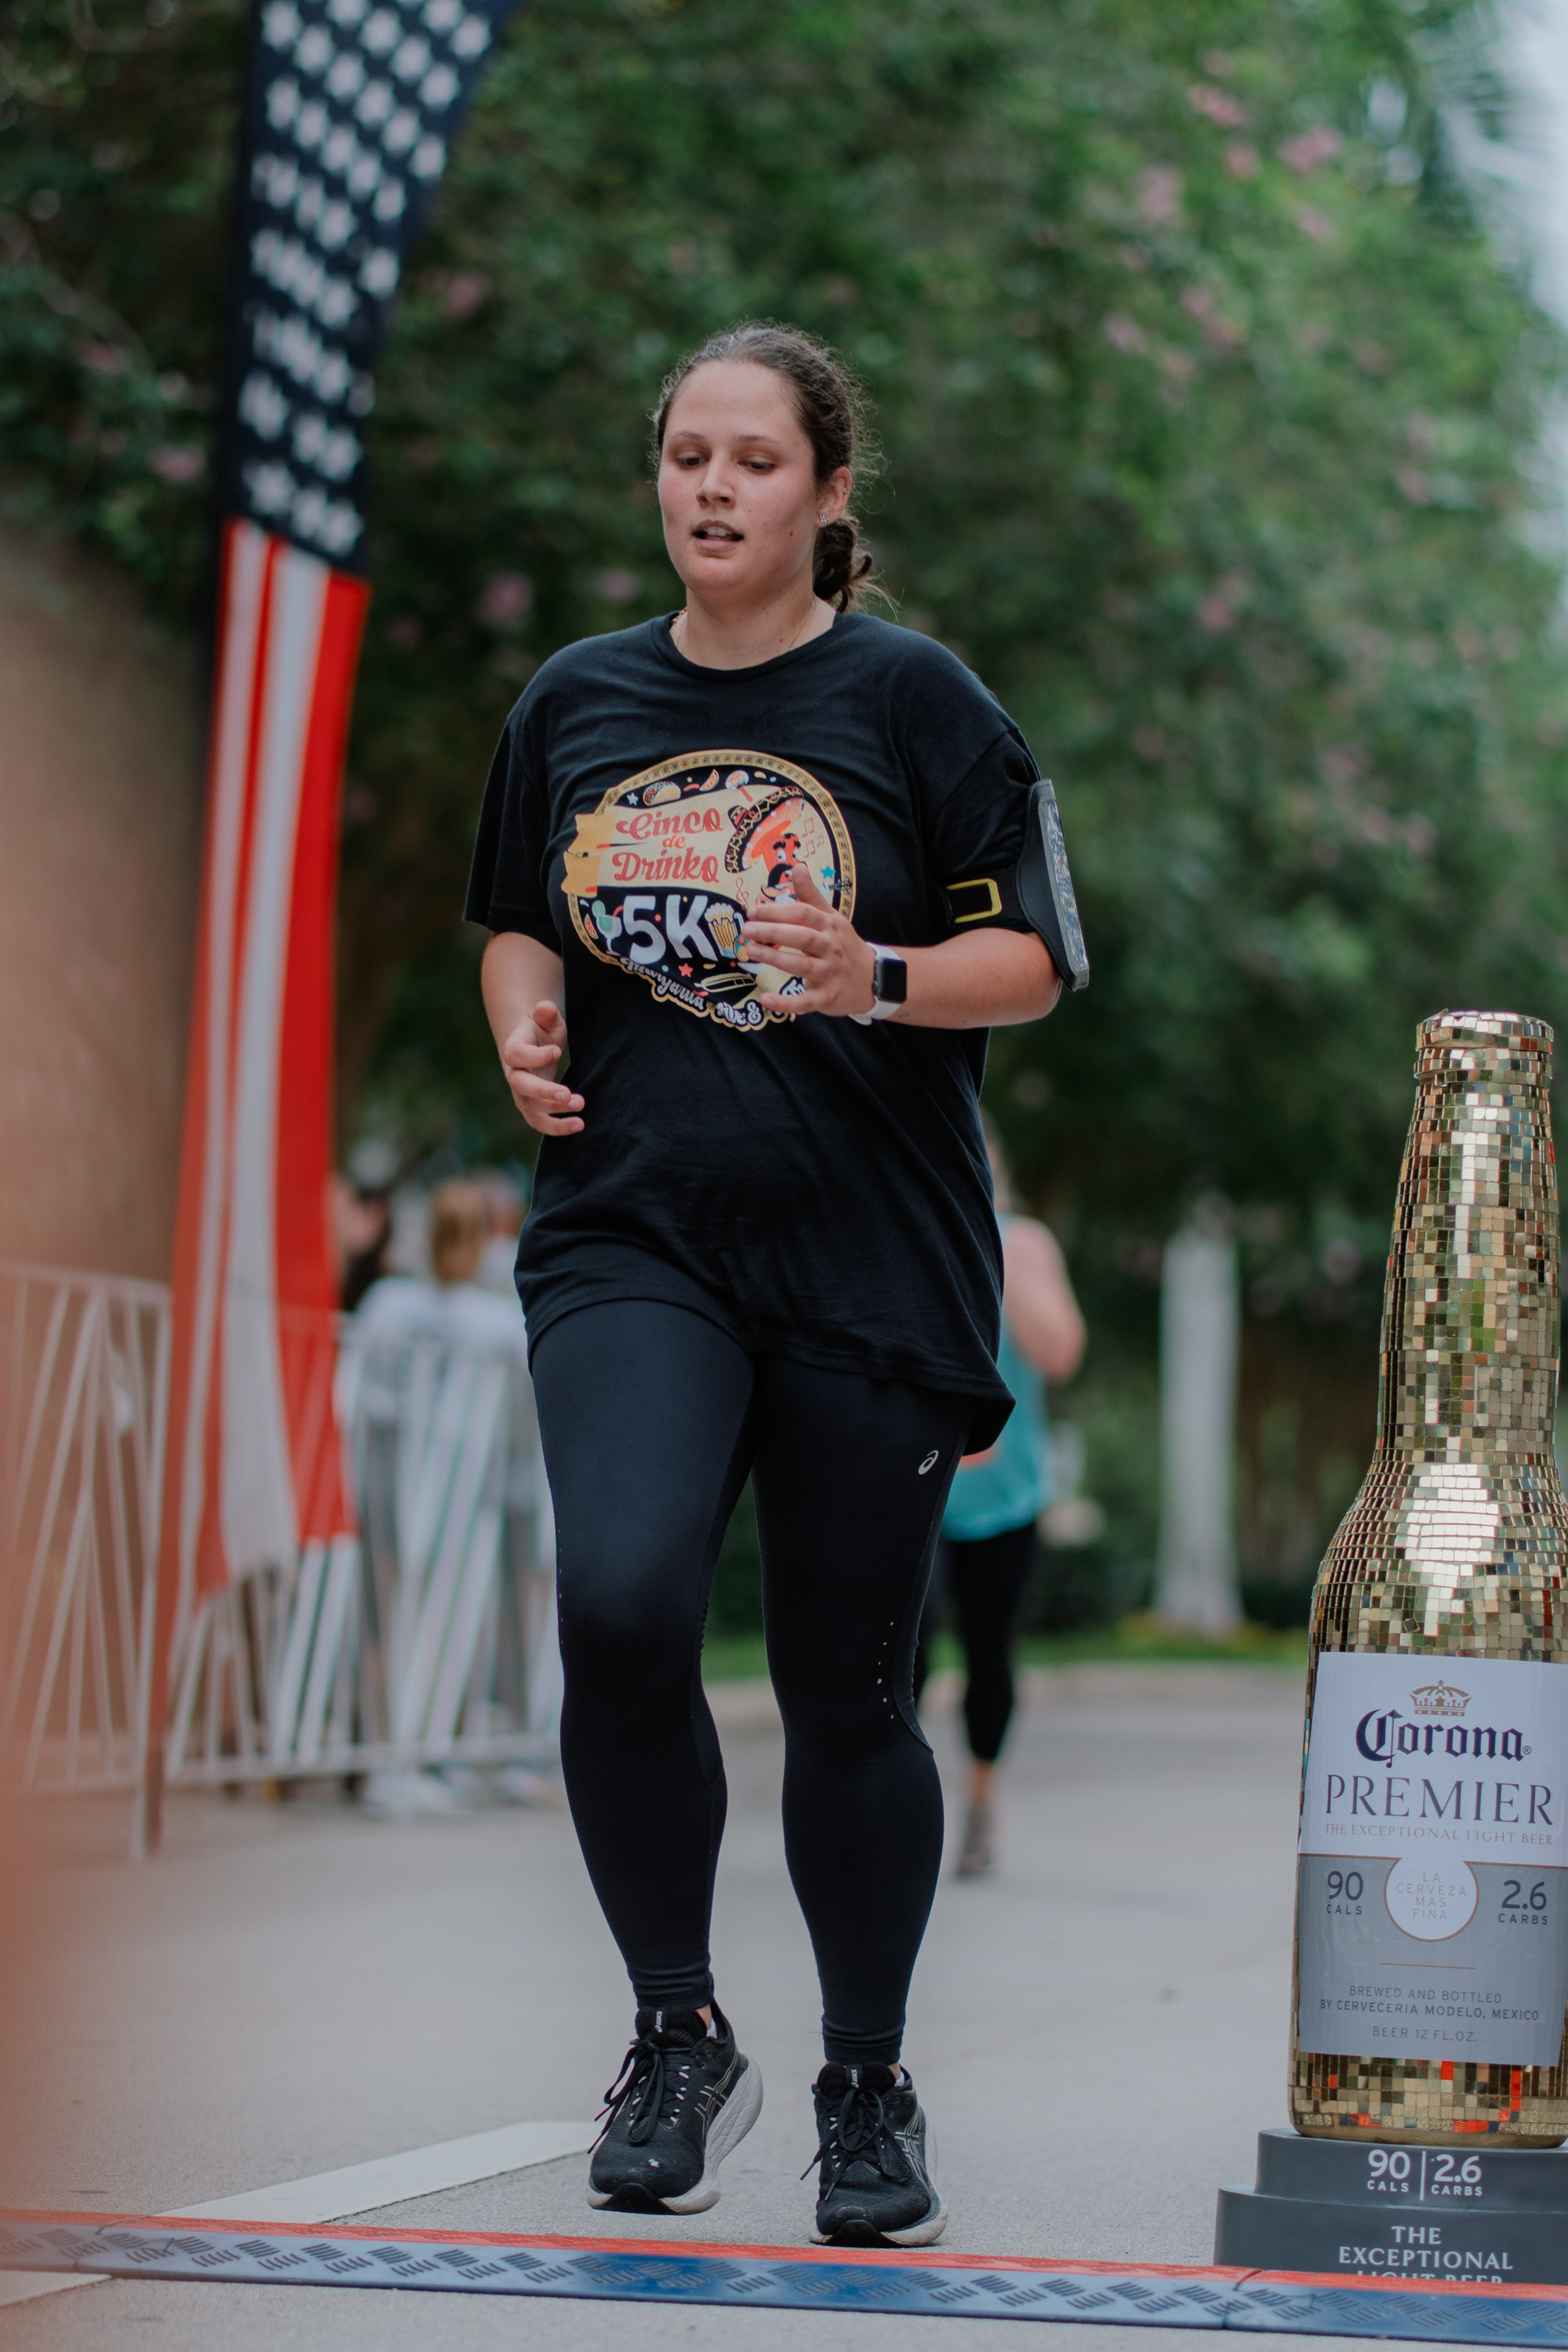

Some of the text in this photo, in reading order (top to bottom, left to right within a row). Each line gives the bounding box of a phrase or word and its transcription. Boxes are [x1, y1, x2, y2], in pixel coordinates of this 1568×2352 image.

[616, 808, 723, 840] Cinco
[662, 835, 686, 848] de
[612, 847, 720, 883] Drinko
[623, 895, 718, 965] 5K
[747, 1001, 762, 1024] &
[1355, 1708, 1525, 1768] Corona
[1325, 1774, 1553, 1825] PREMIER
[1325, 1823, 1552, 1845] THE EXCEPTIONAL LIGHT BEER
[1327, 1871, 1363, 1901] 90
[1423, 1872, 1441, 1883] LA
[1396, 1883, 1466, 1897] CERVEZA
[1501, 1880, 1547, 1910] 2.6
[1327, 1904, 1362, 1915] CALS
[1415, 1898, 1446, 1908] MAS
[1412, 1909, 1448, 1920] FINA
[1498, 1913, 1548, 1925] CARBS
[1349, 1986, 1502, 2003] BREWED AND BOTTLED
[1320, 1999, 1539, 2021] BY CERVECERIA MODELO, MEXICO
[1373, 2027, 1408, 2038] BEER
[1415, 2029, 1428, 2040] 12
[1368, 2149, 1410, 2179] 90
[1434, 2154, 1482, 2183] 2.6
[1367, 2180, 1409, 2193] CALS
[1431, 2184, 1482, 2196] CARBS
[1391, 2226, 1441, 2245] THE
[1339, 2246, 1513, 2270] EXCEPTIONAL
